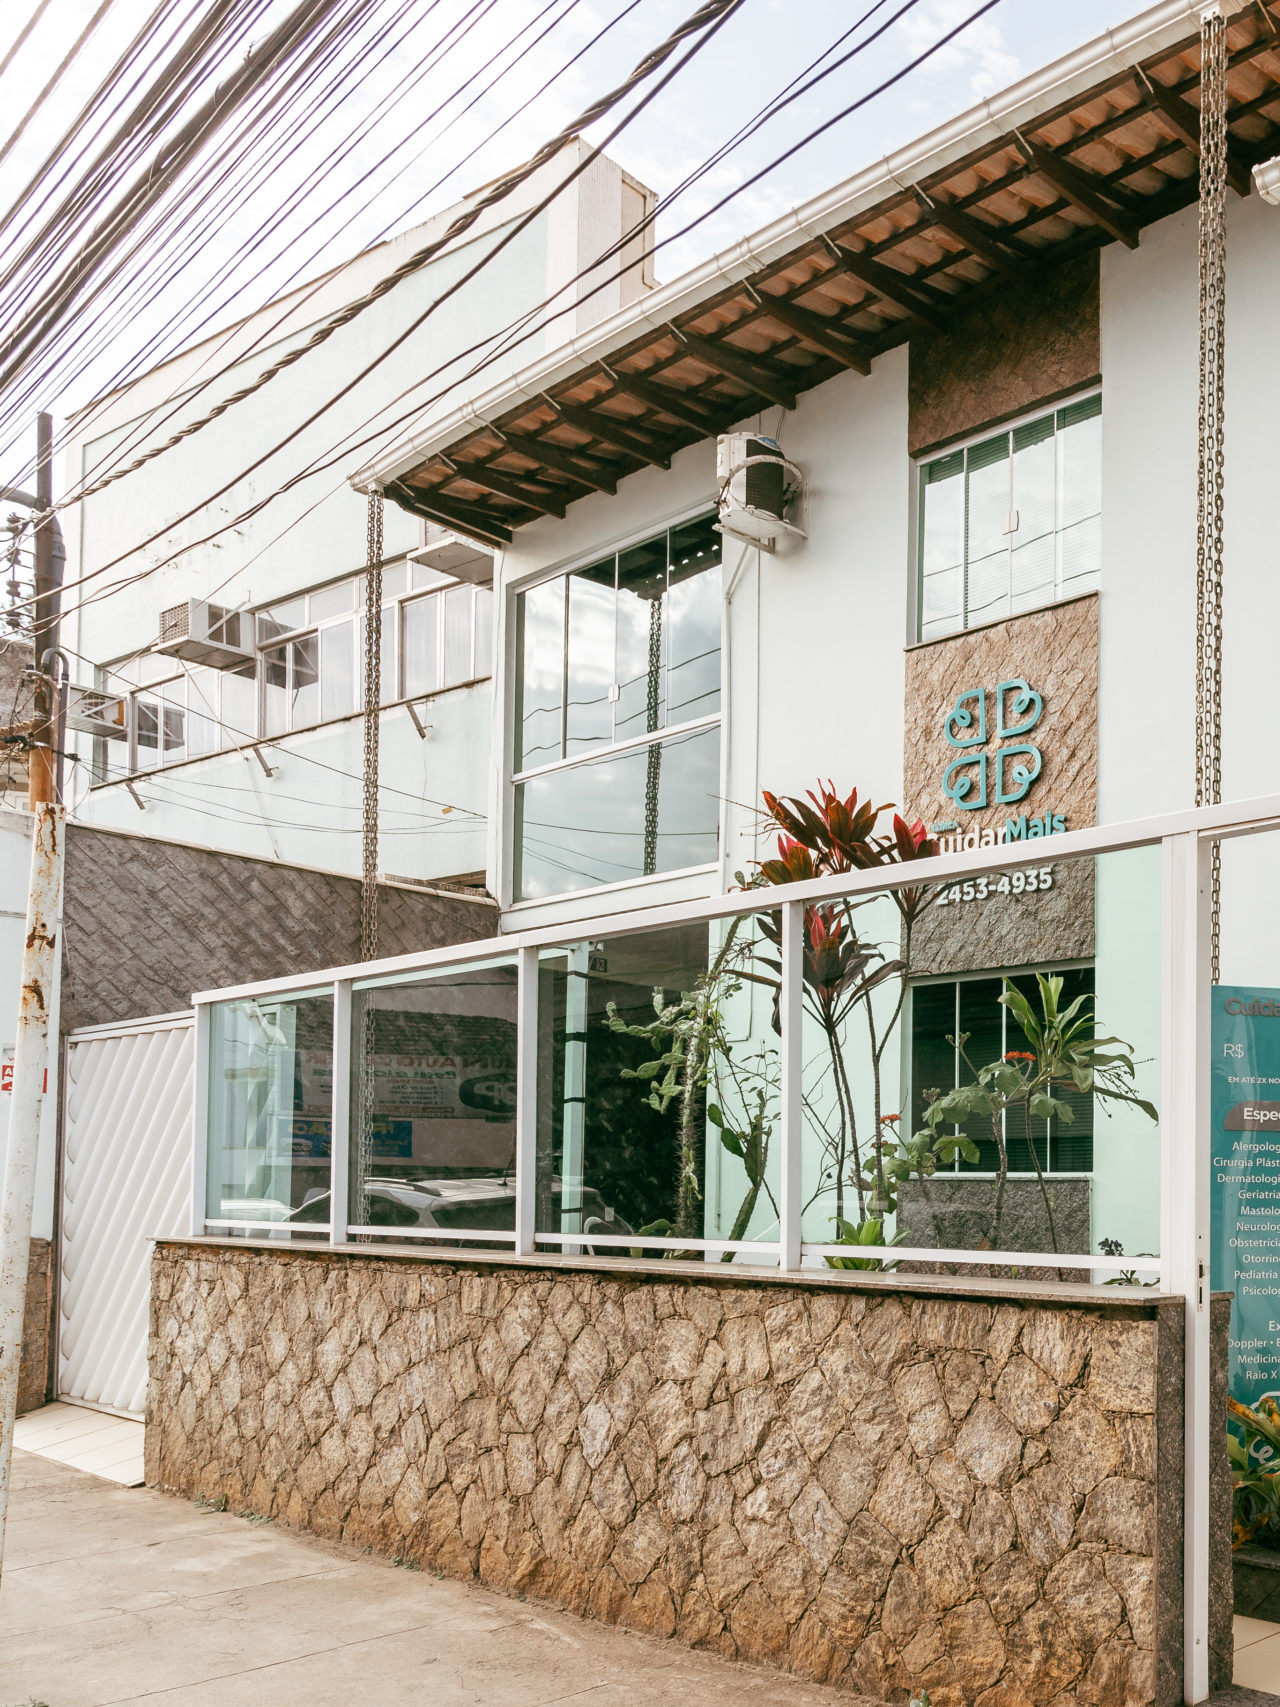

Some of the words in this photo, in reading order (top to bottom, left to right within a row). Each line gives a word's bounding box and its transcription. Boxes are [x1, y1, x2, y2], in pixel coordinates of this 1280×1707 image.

[936, 867, 1053, 906] 2453-4935
[1223, 1044, 1245, 1058] R$
[1213, 1158, 1253, 1168] Cirurgia
[1238, 1190, 1280, 1199] Geriatria
[1234, 1270, 1278, 1279] Pediatria
[1228, 1339, 1268, 1349] Doppler
[1246, 1370, 1268, 1380] Raio
[1271, 1370, 1278, 1379] X
